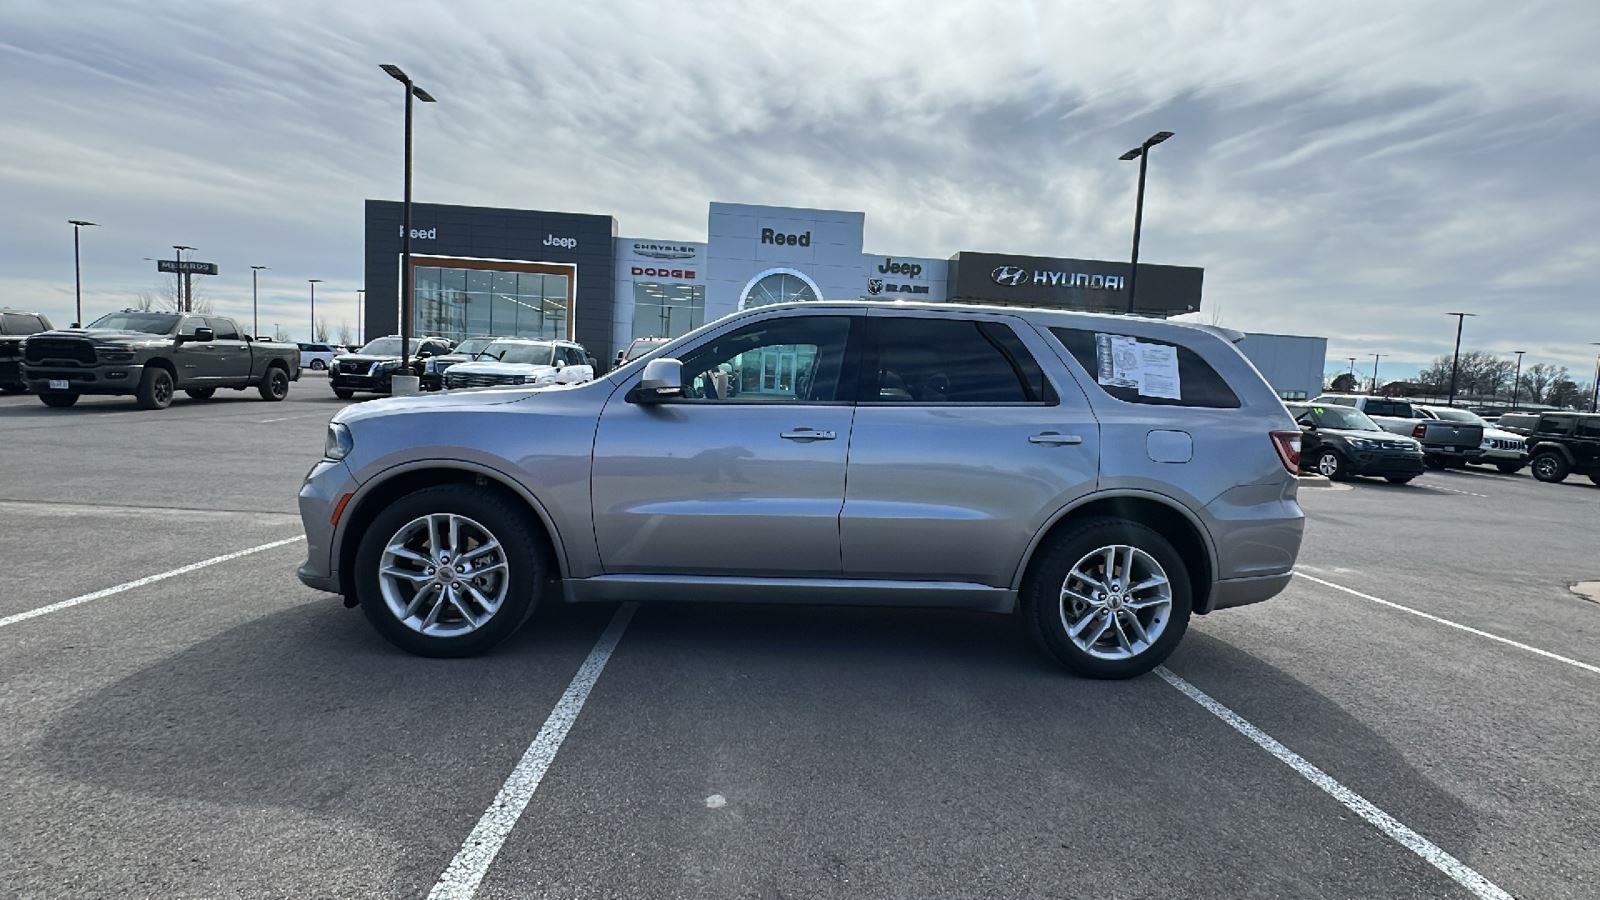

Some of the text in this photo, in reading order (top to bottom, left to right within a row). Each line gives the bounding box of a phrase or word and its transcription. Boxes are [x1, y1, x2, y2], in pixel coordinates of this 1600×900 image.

[543, 234, 577, 249] Jeep
[761, 227, 811, 247] Reed
[634, 243, 696, 253] CHRYSLER
[631, 266, 696, 279] DODGE
[878, 257, 922, 279] Jeep
[1033, 270, 1124, 290] HYUNDAI
[885, 283, 930, 294] RAM
